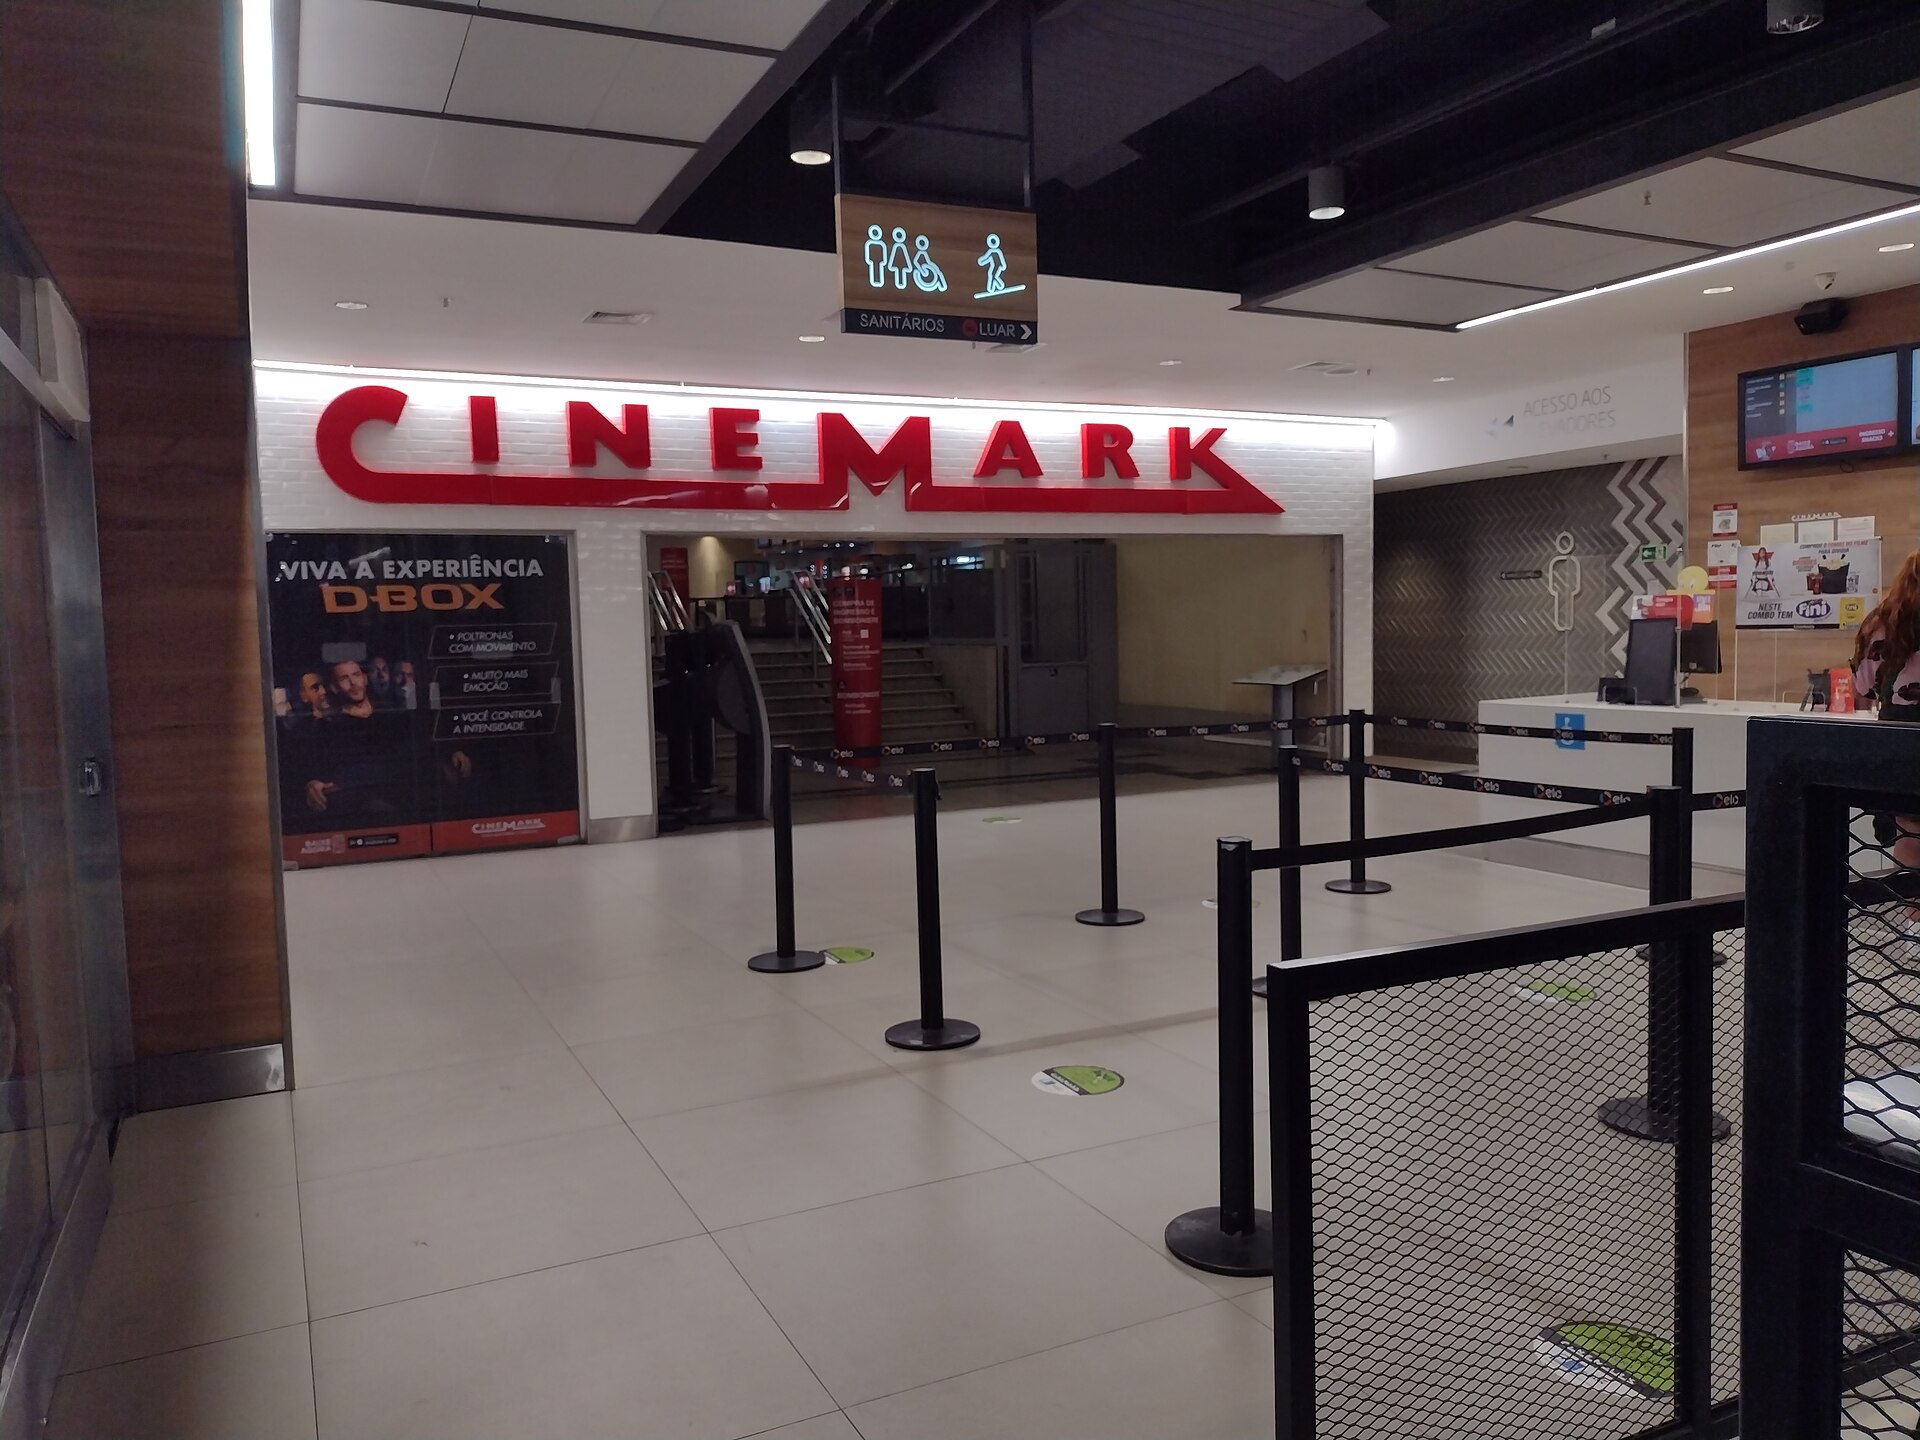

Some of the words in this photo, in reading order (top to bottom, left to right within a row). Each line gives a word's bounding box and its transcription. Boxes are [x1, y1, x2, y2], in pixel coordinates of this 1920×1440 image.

[860, 313, 945, 333] SANITÁRIOS
[979, 322, 1016, 337] LUAR
[1523, 392, 1577, 417] ACESSO
[1581, 385, 1612, 407] AOS
[315, 385, 1284, 514] CINEMARK
[280, 560, 348, 581] VIVA
[354, 560, 375, 580] A
[382, 553, 544, 580] EXPERIÊNCIA
[320, 582, 505, 614] D-BOX
[1758, 602, 1783, 611] NESTE
[1798, 601, 1827, 617] Fini
[1747, 611, 1775, 620] COMBO
[1777, 611, 1793, 619] TEM
[457, 630, 514, 642] POLTRONAS
[448, 643, 474, 654] COM
[475, 641, 537, 652] MOVIMENTO
[471, 669, 503, 680] MUITO
[504, 669, 529, 679] MAIS
[463, 680, 509, 693] EMOÇÃO
[461, 709, 489, 722] VOCÊ
[491, 709, 543, 720] CONTROLA
[453, 725, 462, 734] A
[464, 721, 525, 733] INTENSIDADE
[1723, 794, 1739, 806] elo
[471, 818, 547, 834] CINEMARK
